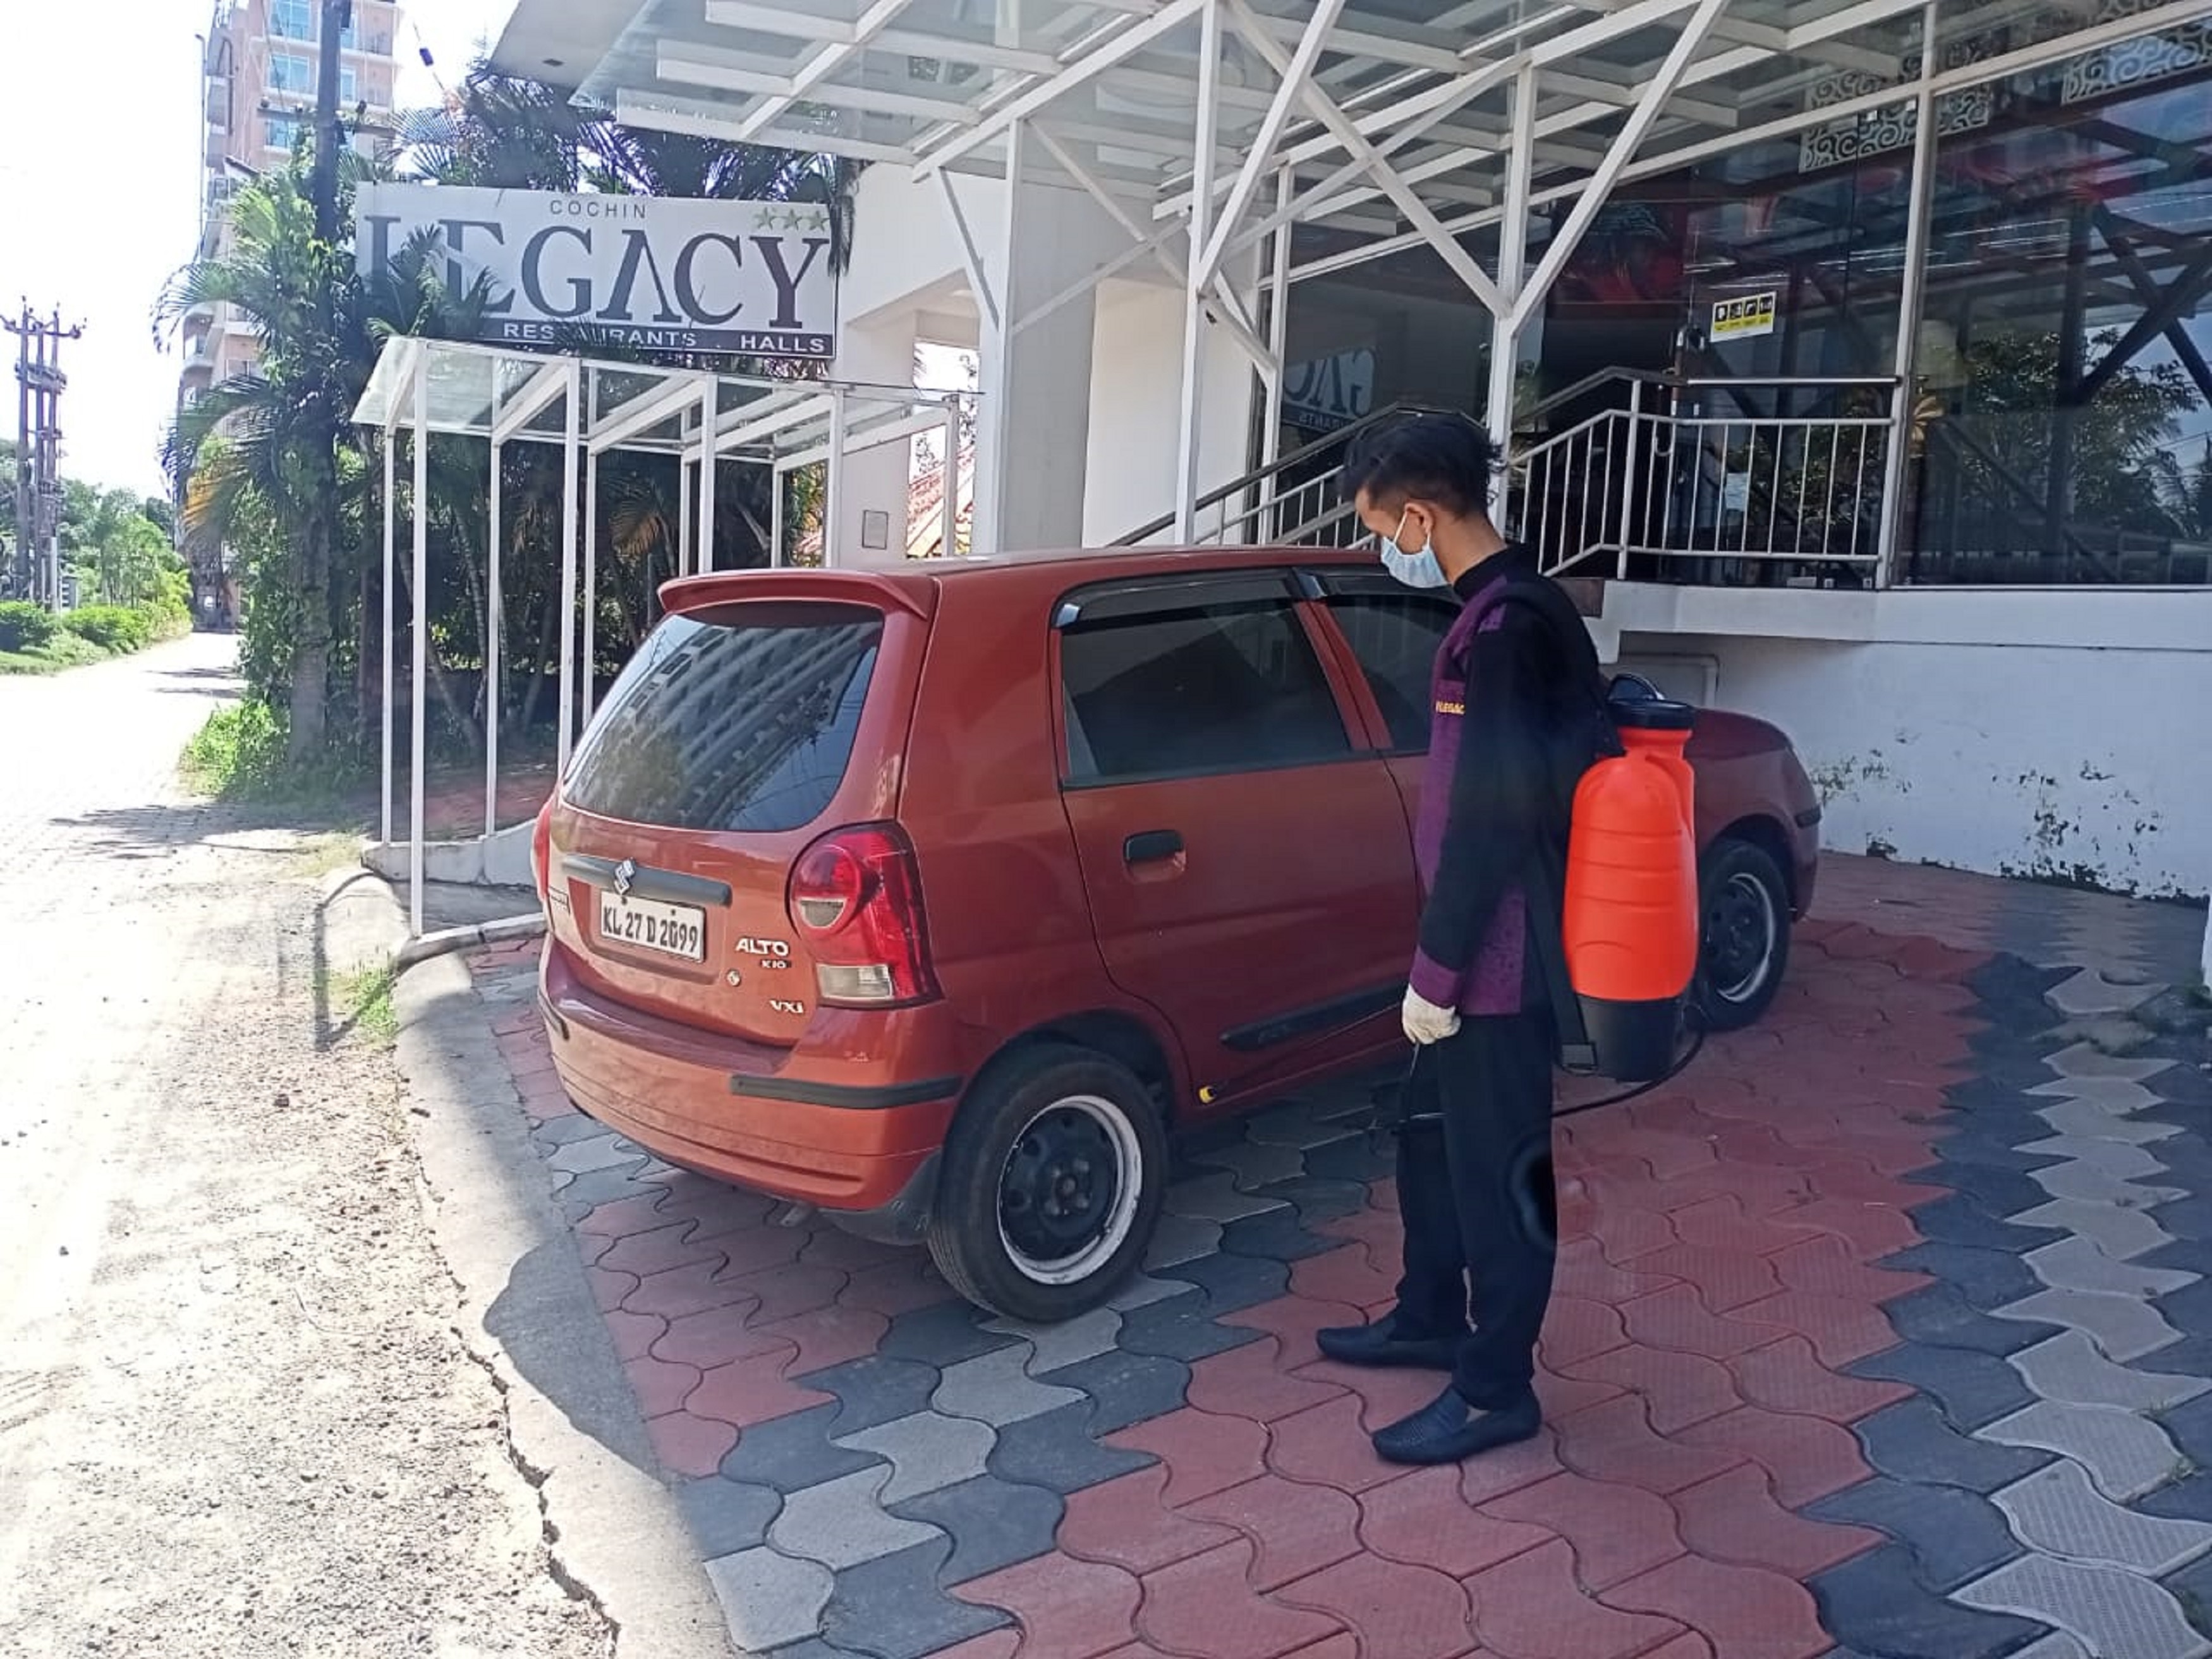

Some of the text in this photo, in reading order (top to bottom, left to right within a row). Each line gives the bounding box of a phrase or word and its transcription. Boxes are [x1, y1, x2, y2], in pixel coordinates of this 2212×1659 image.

[550, 199, 647, 219] COCHIN
[503, 321, 825, 352] RESURANTS HALLS
[603, 906, 622, 935] KL
[626, 912, 642, 940] 27
[647, 916, 657, 943] D
[735, 937, 789, 956] ALTO
